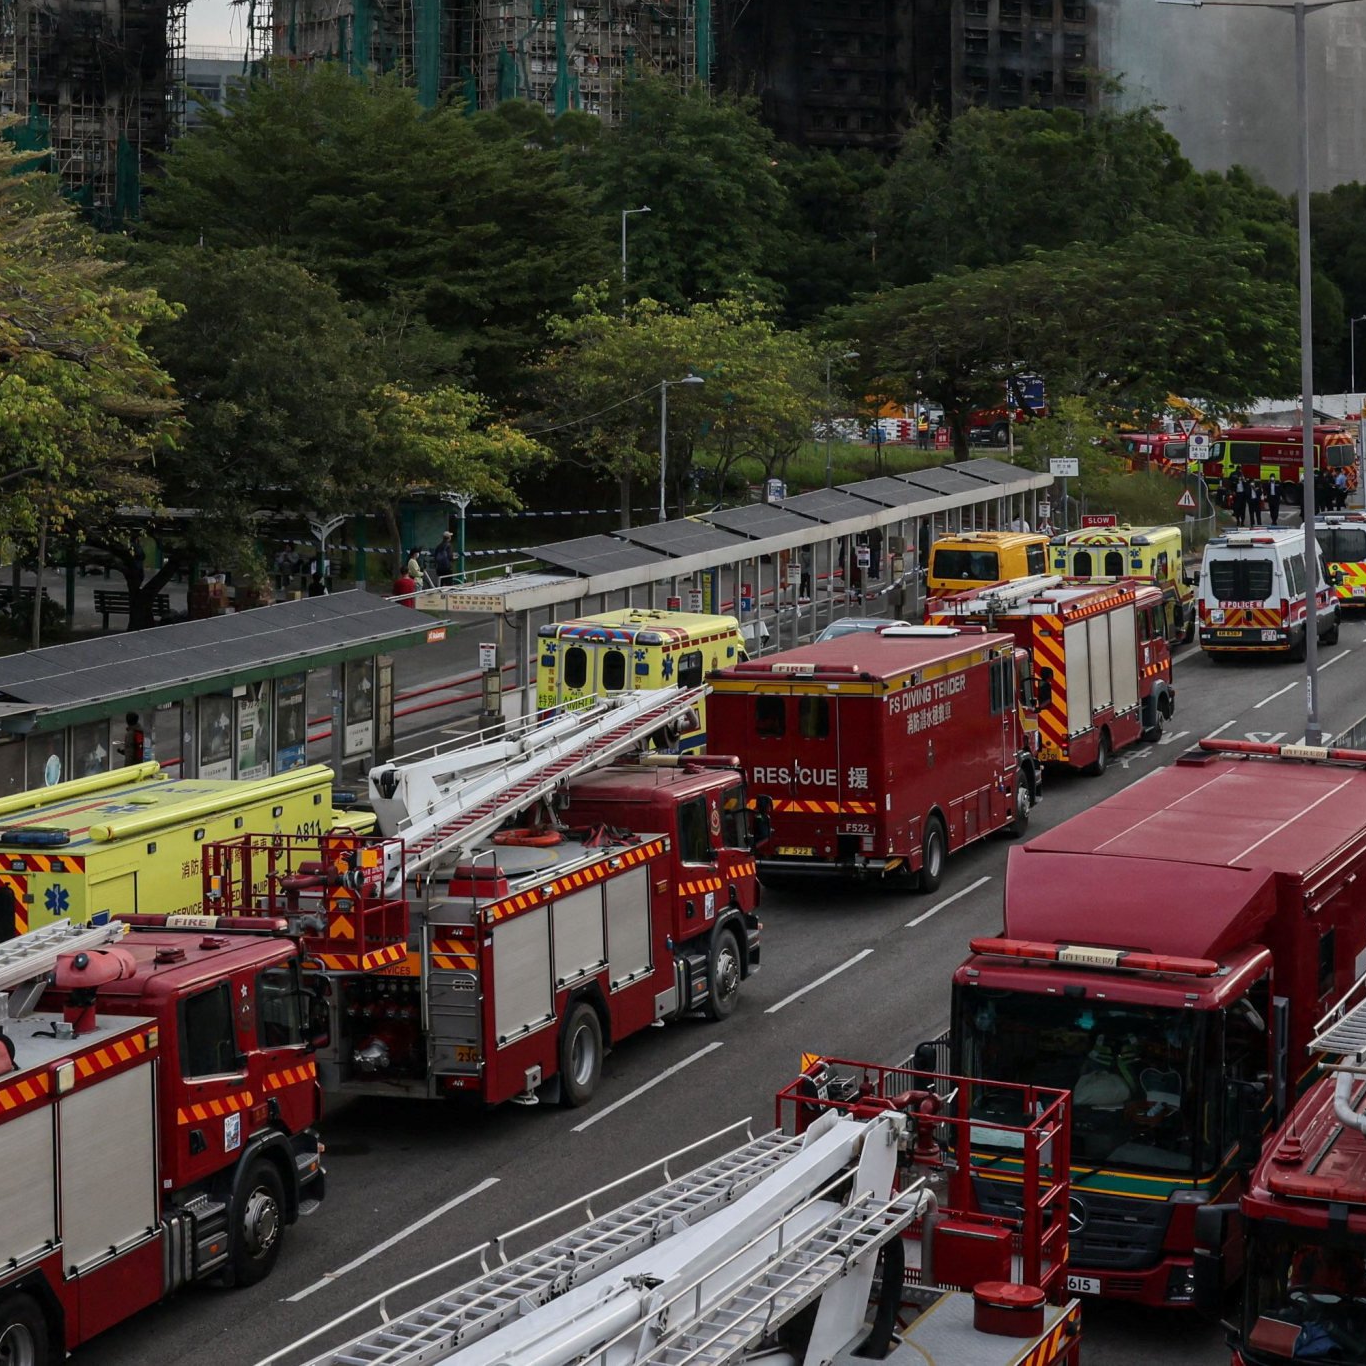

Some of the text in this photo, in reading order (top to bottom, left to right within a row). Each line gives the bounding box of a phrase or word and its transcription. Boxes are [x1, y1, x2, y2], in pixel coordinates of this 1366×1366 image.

[1088, 516, 1110, 524] SLOW
[1227, 601, 1254, 609] POLICE
[890, 674, 966, 716] FS DIVING TENDER
[754, 767, 868, 789] RESCUE 援
[295, 819, 321, 844] A811
[846, 824, 870, 833] F522
[175, 918, 208, 927] FIRE
[1075, 955, 1102, 964] FIRE
[1068, 1277, 1092, 1291] 615
